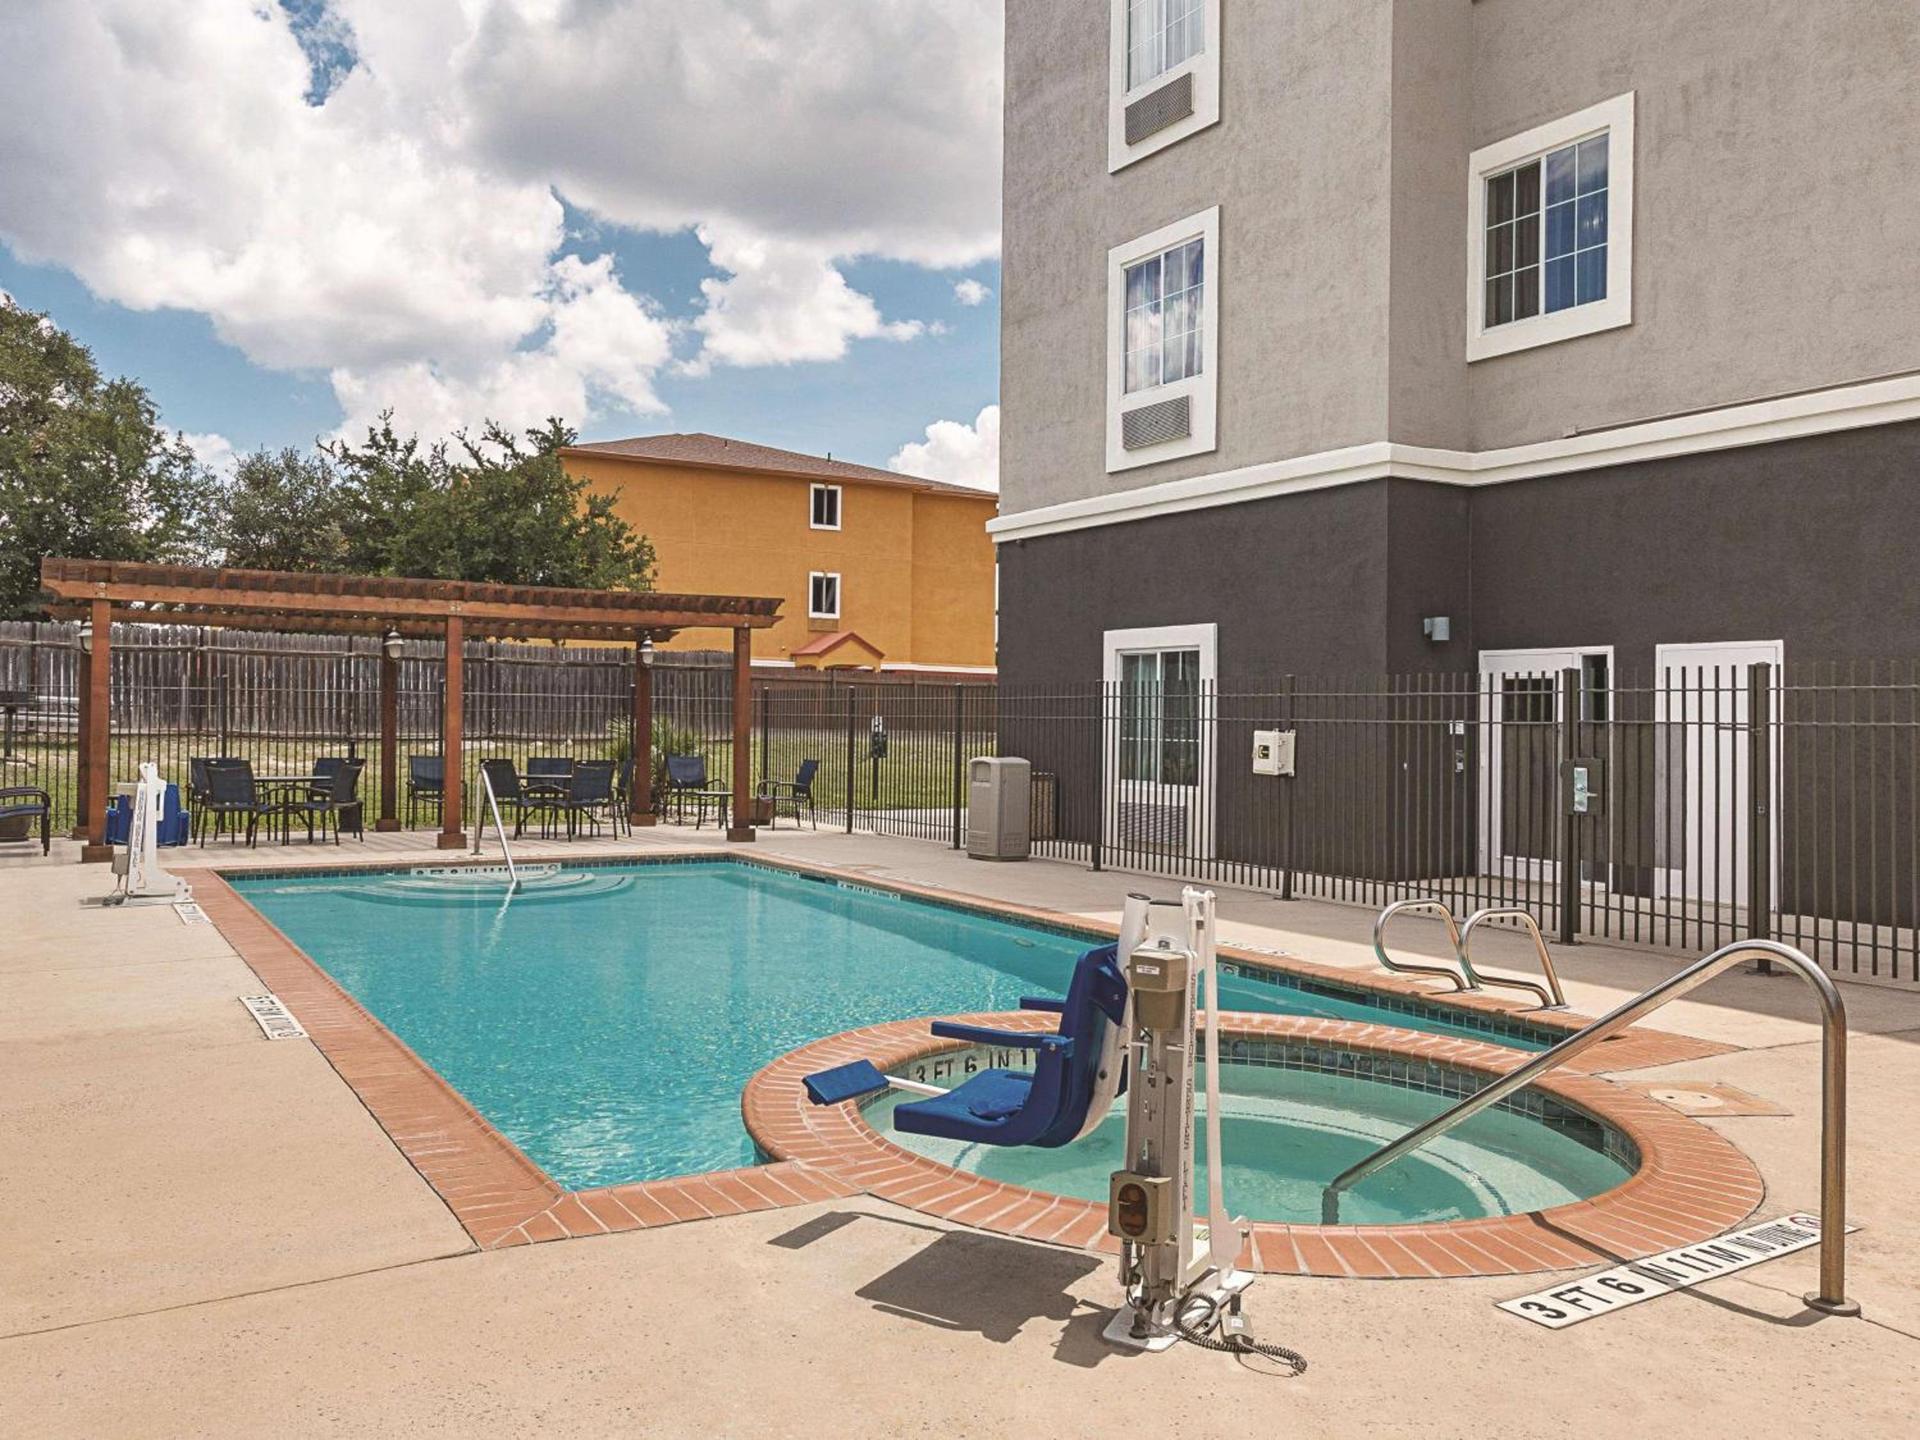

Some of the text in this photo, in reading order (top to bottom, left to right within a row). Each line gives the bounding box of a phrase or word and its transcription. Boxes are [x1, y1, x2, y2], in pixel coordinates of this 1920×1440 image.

[915, 1064, 926, 1083] 3
[933, 1057, 954, 1080] FT
[964, 1055, 977, 1073] 6
[989, 1048, 1010, 1069] IN
[1519, 1301, 1567, 1319] 3
[1549, 1285, 1614, 1311] FT
[1597, 1277, 1645, 1295] 6
[1628, 1262, 1690, 1286] IN
